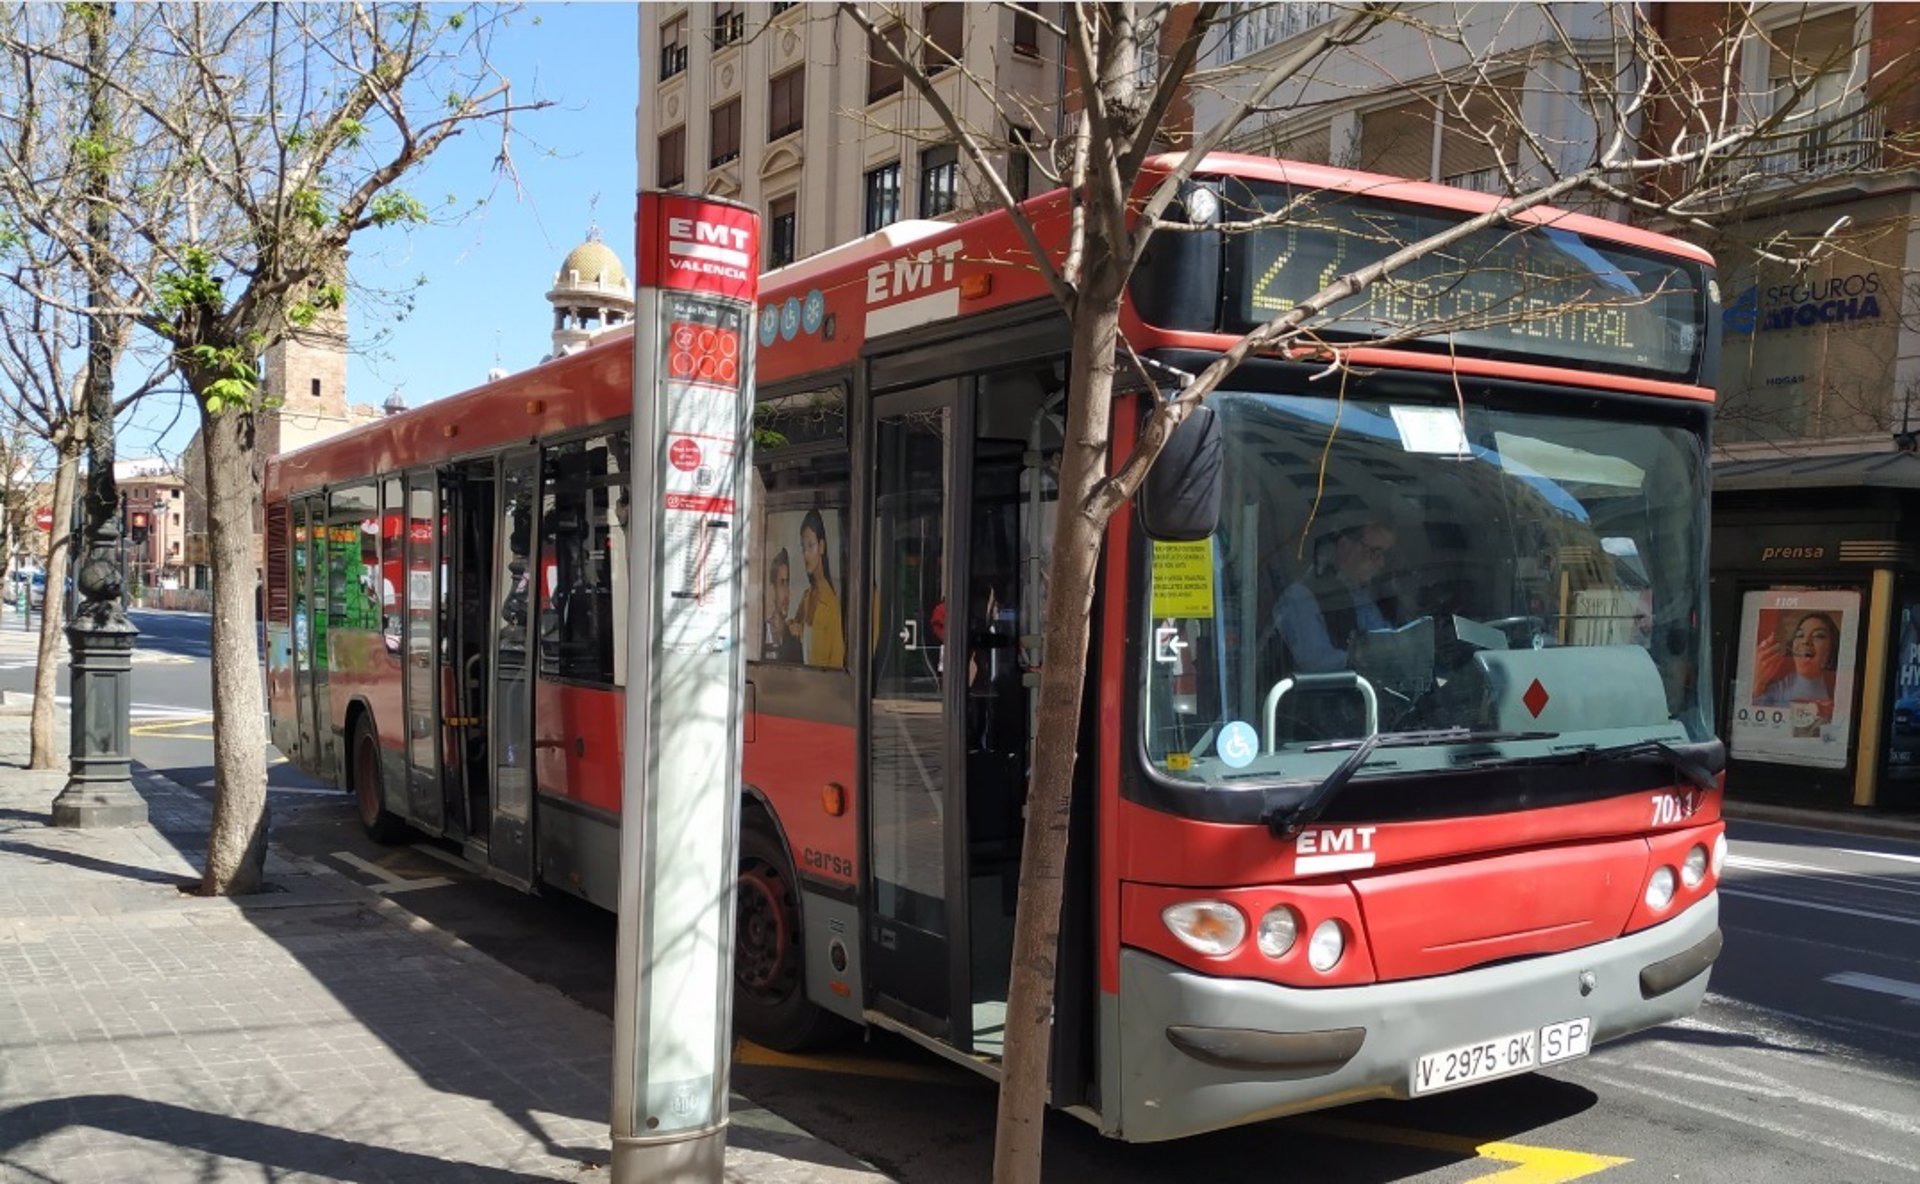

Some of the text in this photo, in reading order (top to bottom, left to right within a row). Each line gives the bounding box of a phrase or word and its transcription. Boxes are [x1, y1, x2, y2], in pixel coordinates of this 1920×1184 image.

[669, 217, 749, 251] EMT
[669, 258, 748, 280] VALENCIA
[866, 239, 964, 304] EMT
[1767, 272, 1881, 304] SEGUROS
[1507, 296, 1635, 349] CENTRAL
[1761, 296, 1881, 332] ATOCHA
[1762, 546, 1824, 561] prensa
[1651, 791, 1693, 827] 7011
[1296, 827, 1376, 854] EMT
[803, 847, 853, 877] carsa
[1548, 1024, 1583, 1057] SP
